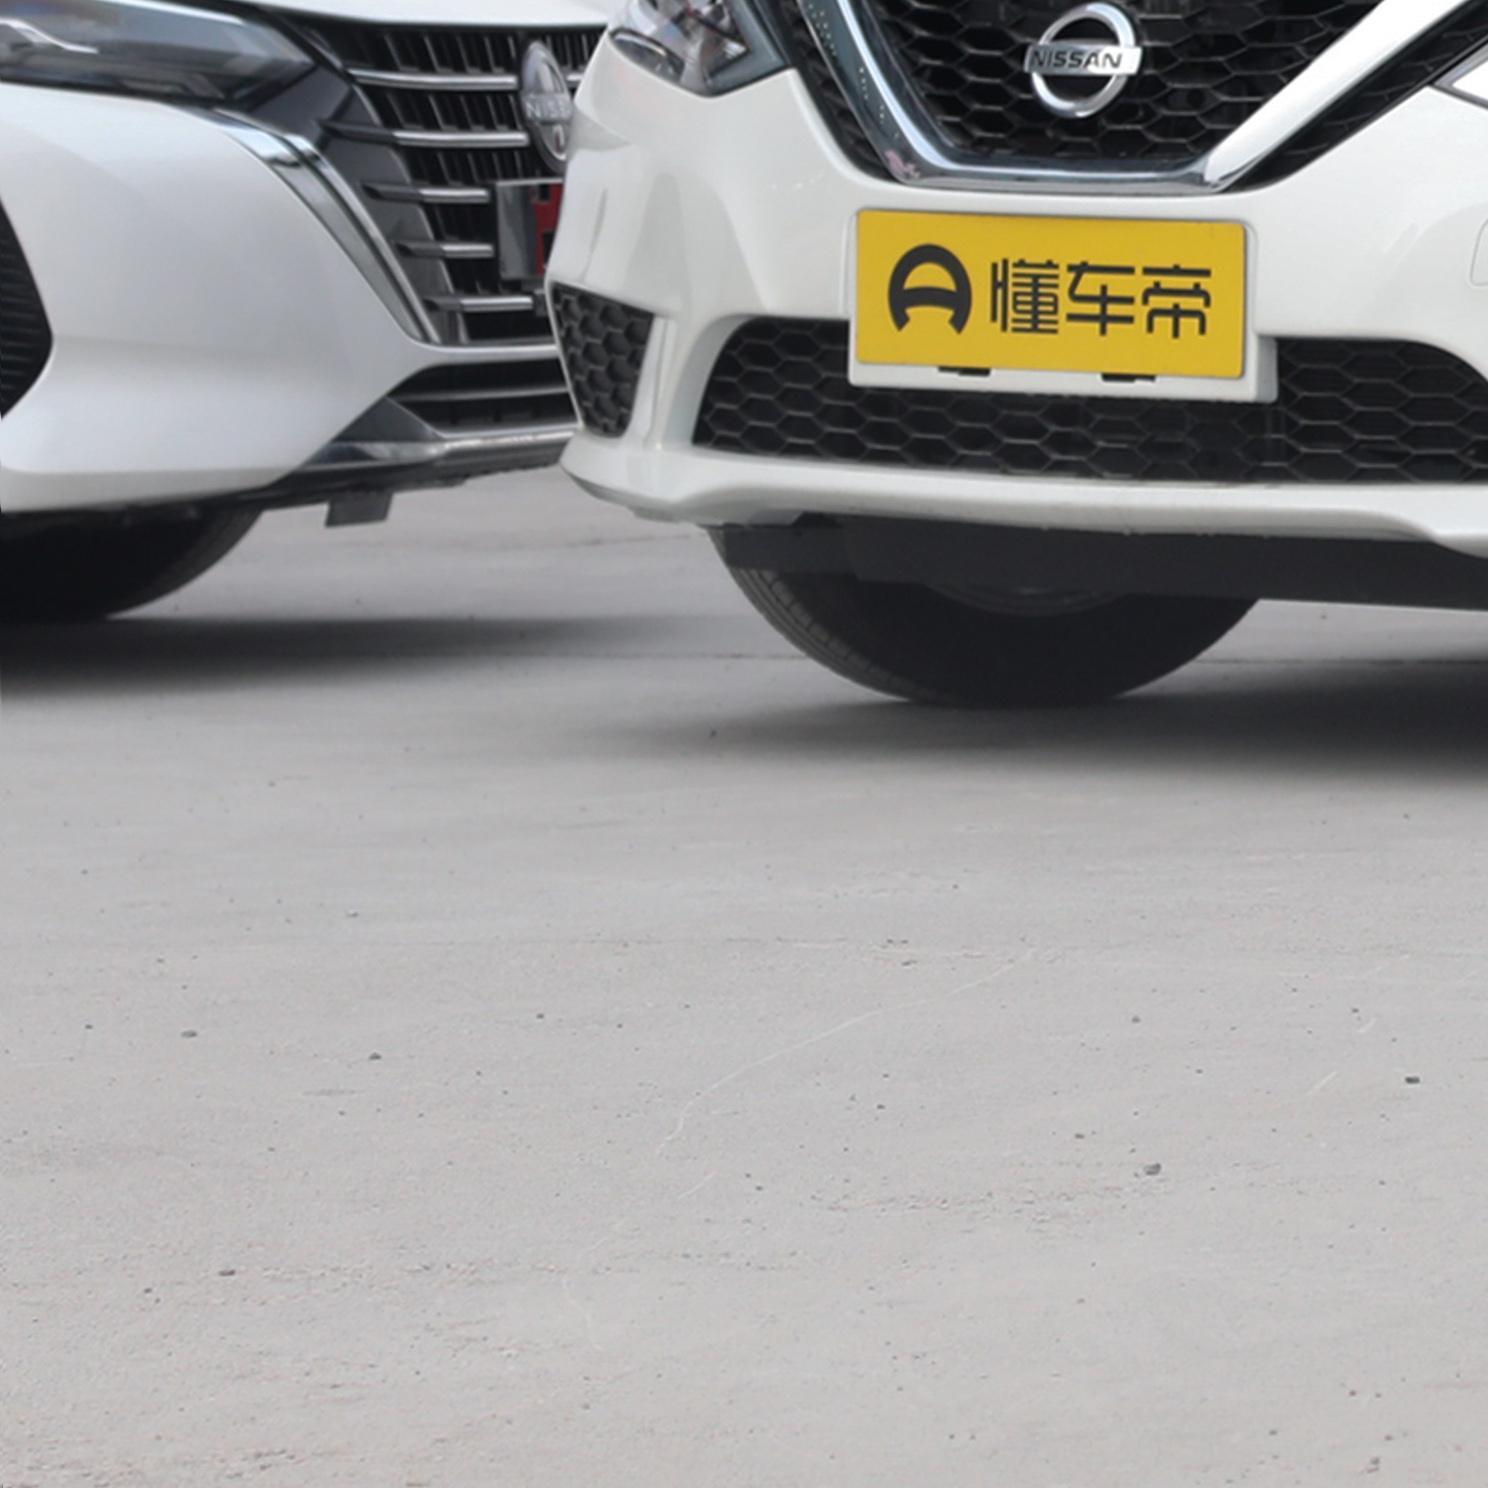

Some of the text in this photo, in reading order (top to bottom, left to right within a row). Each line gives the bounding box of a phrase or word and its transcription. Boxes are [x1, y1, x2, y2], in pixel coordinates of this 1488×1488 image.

[1031, 50, 1123, 69] NISSAN
[525, 100, 573, 119] NISS
[990, 258, 1211, 338] 懂车帝
